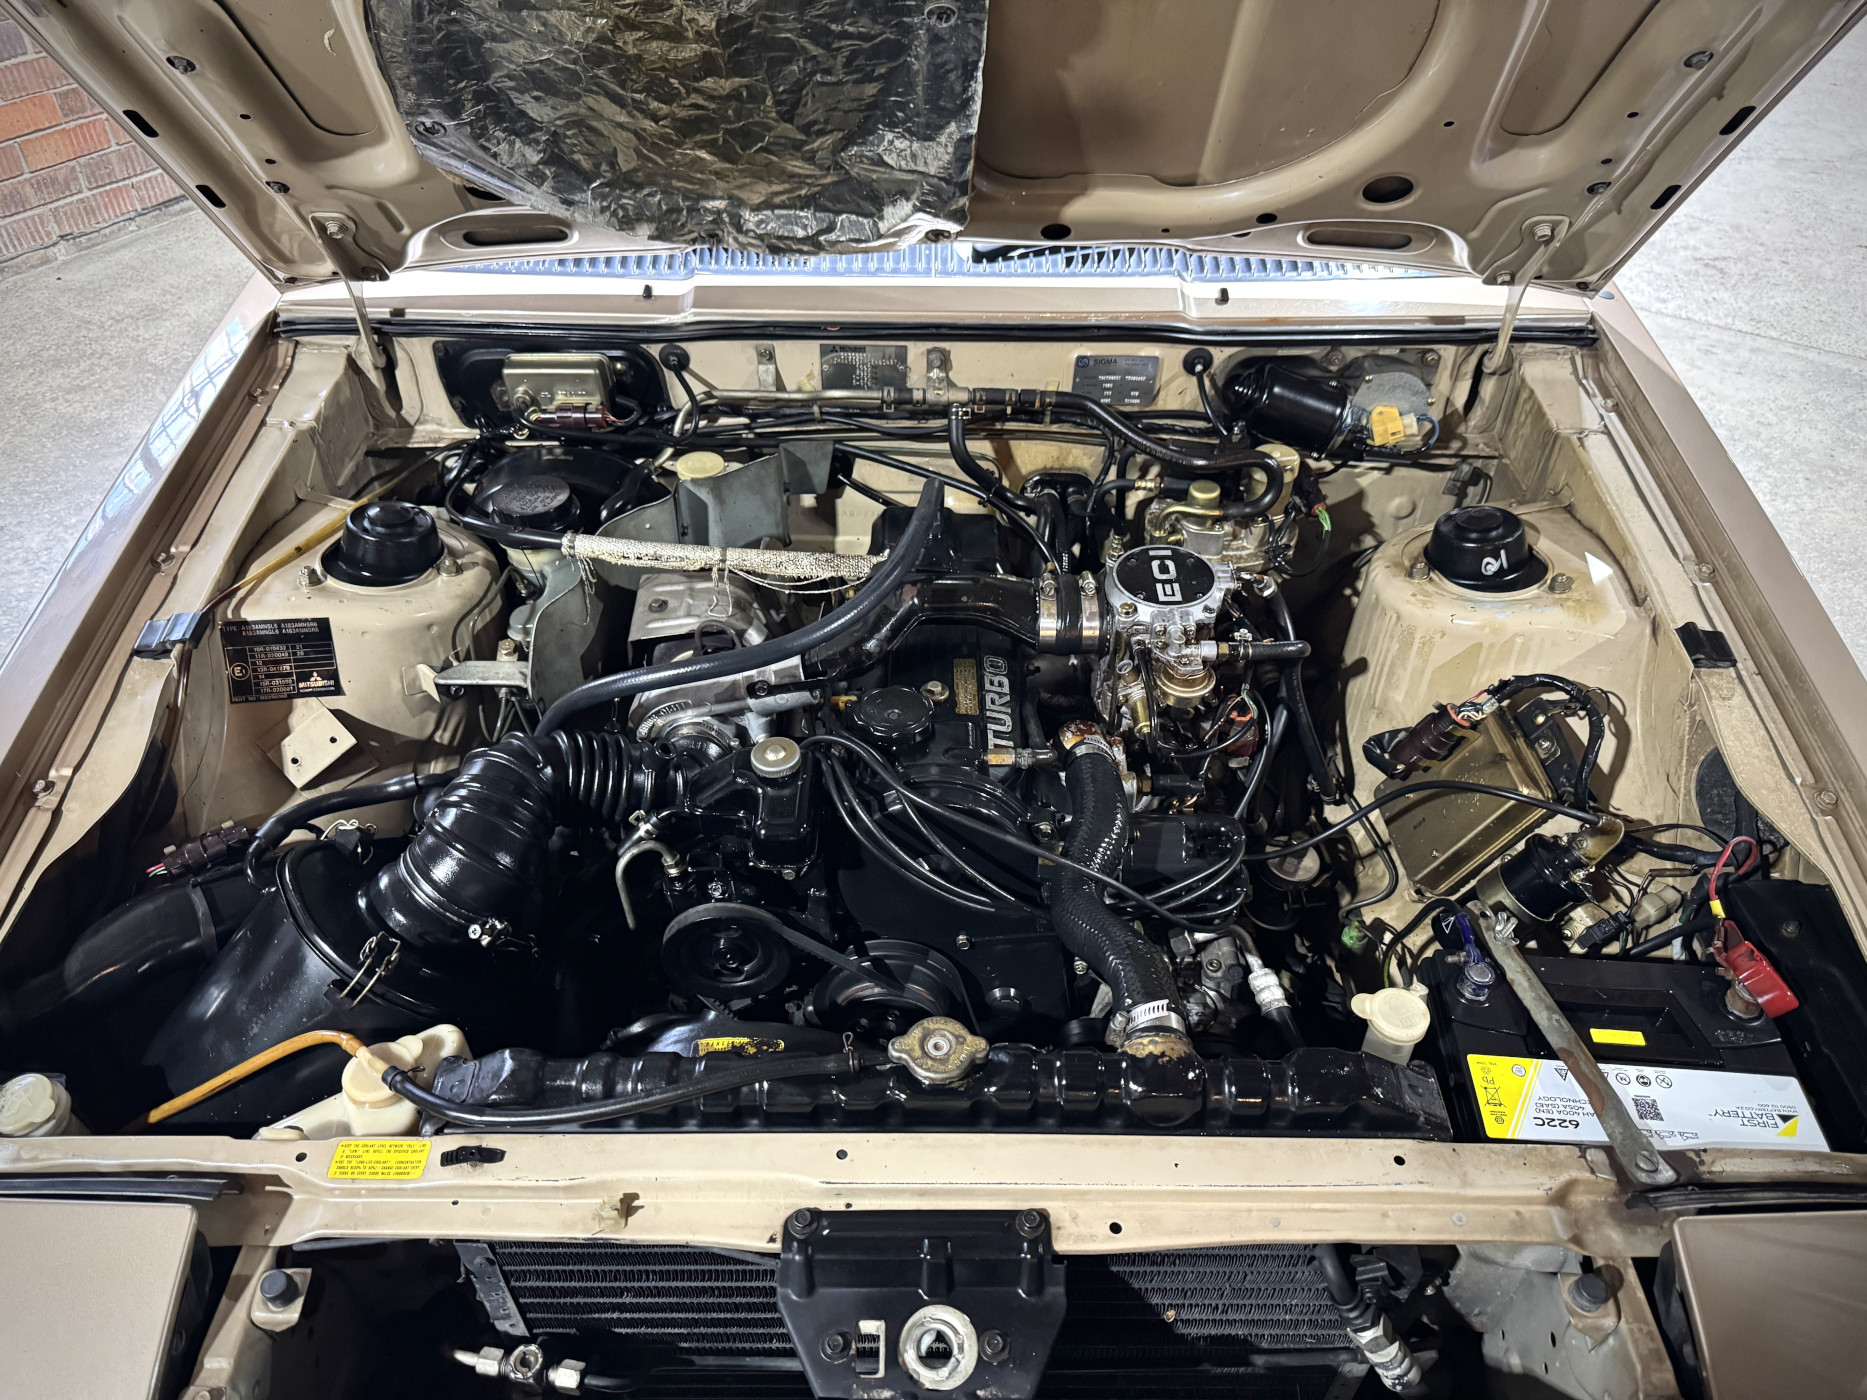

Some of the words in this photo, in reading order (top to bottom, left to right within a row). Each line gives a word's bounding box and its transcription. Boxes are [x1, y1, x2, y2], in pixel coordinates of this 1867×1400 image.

[1148, 550, 1182, 602] ECI
[984, 655, 1014, 750] TURBO
[1482, 1076, 1495, 1085] Pb
[1538, 1096, 1590, 1105] CHNOLOGY
[1714, 1109, 1775, 1120] BATTERY
[1533, 1117, 1579, 1129] 622C
[1740, 1119, 1779, 1128] FIRST
